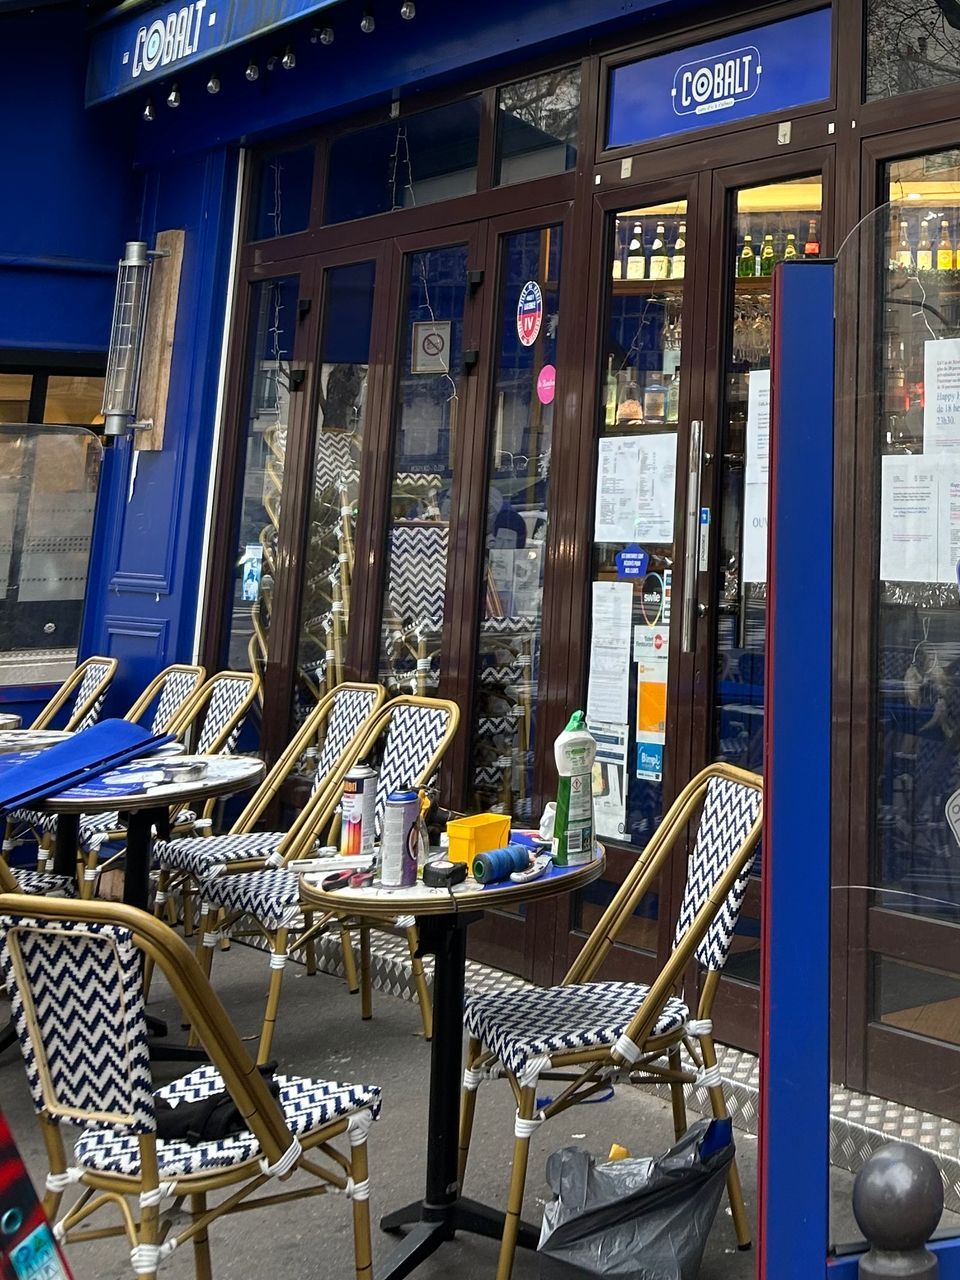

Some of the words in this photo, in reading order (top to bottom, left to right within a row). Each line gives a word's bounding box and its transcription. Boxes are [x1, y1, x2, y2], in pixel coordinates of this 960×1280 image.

[682, 55, 752, 107] COBALT
[524, 316, 534, 331] IV
[937, 392, 955, 402] Happy
[936, 405, 943, 413] de
[644, 592, 661, 602] swile
